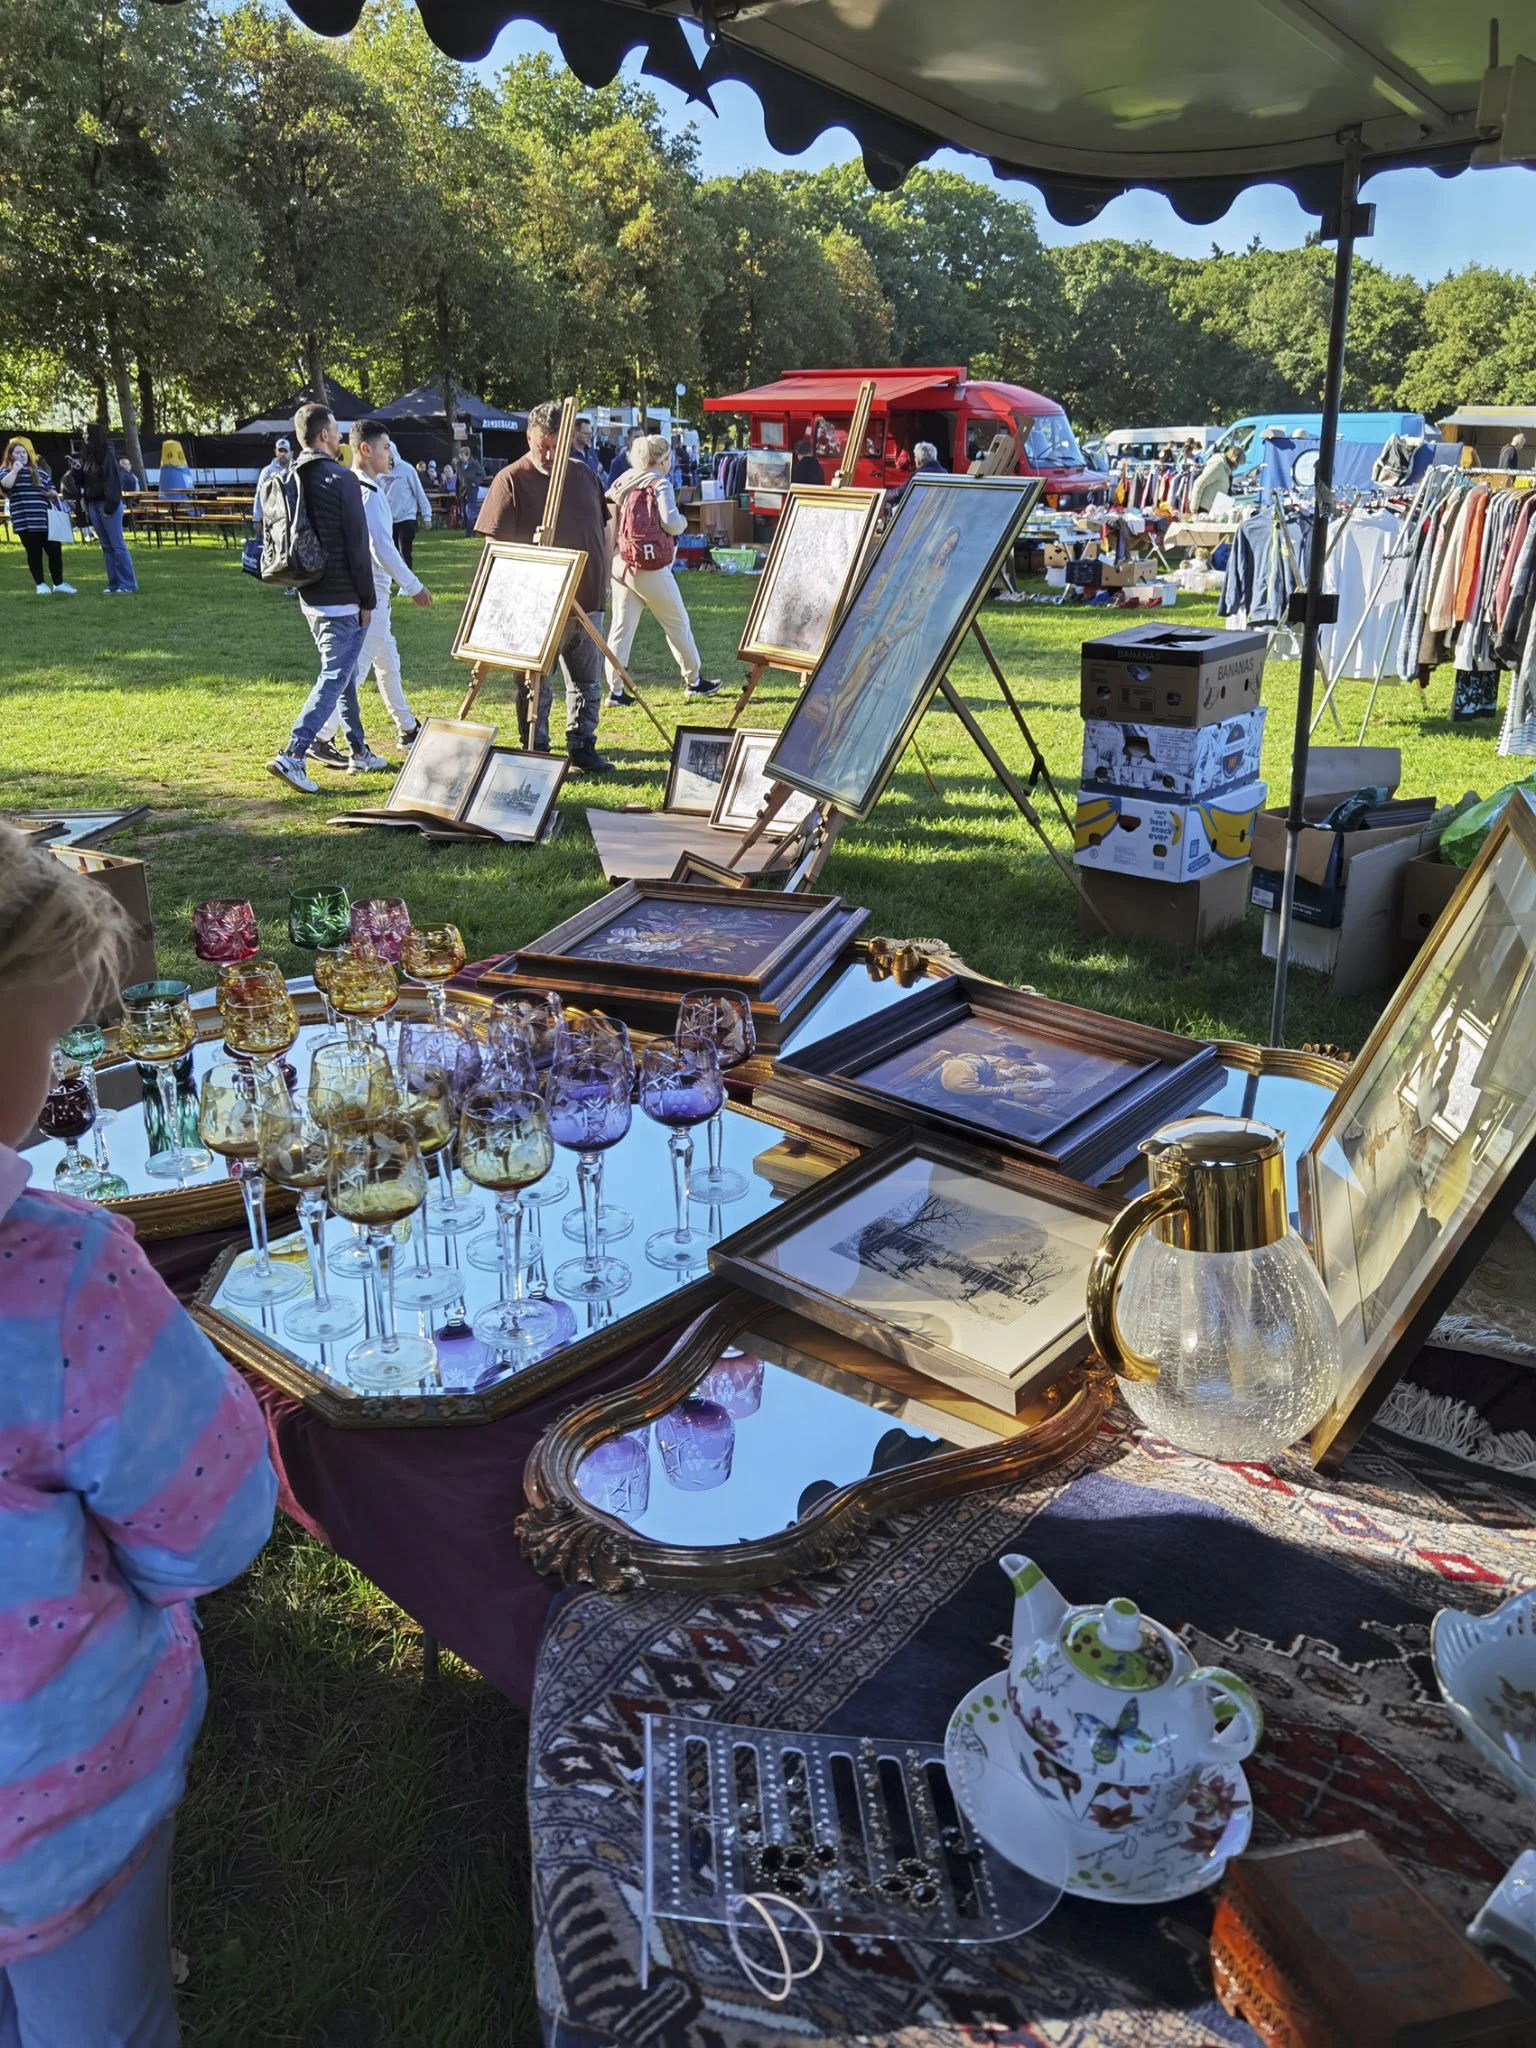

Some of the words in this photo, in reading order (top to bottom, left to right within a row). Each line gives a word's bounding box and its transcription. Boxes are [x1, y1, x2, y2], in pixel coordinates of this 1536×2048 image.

[643, 543, 656, 560] R
[1117, 650, 1160, 661] BANANAS
[1217, 657, 1254, 681] BANANAS
[1150, 818, 1167, 826] best
[1151, 826, 1172, 835] snack
[1148, 833, 1168, 842] ever
